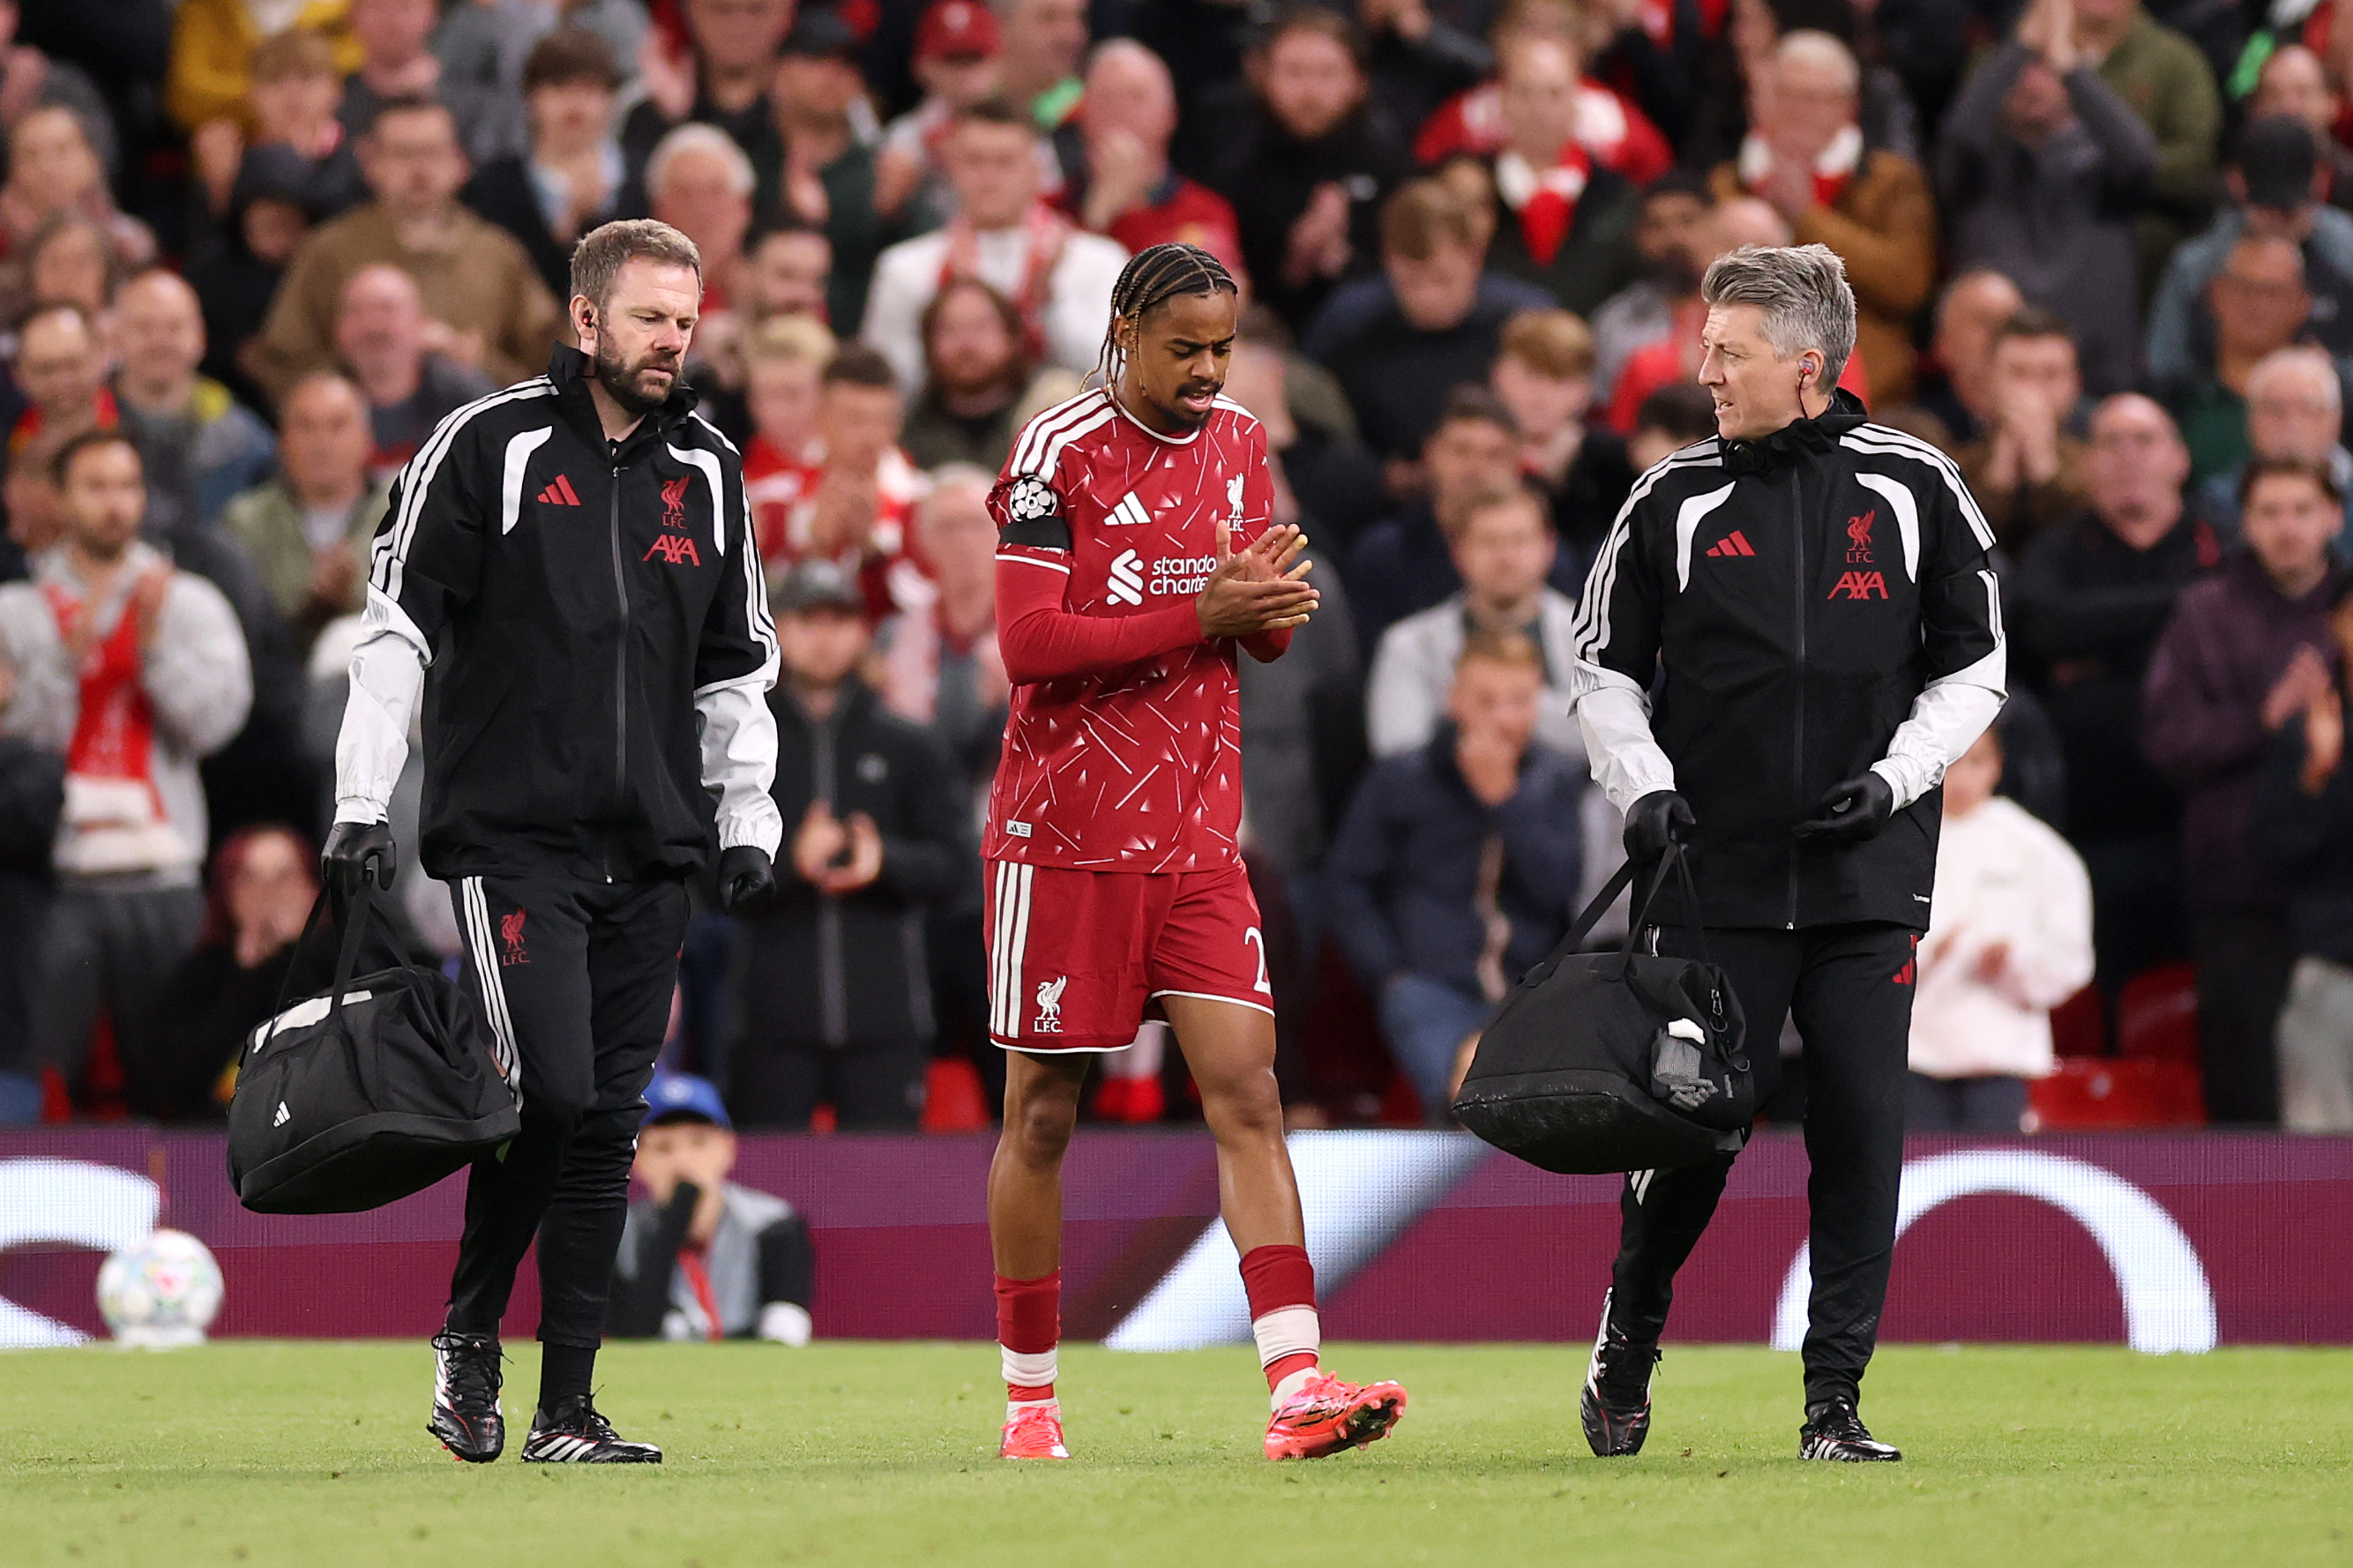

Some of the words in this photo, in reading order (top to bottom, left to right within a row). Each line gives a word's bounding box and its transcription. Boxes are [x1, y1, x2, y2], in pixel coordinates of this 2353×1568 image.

[642, 534, 701, 567] AXA
[1152, 554, 1217, 576] standa
[1149, 574, 1209, 595] charte
[1826, 571, 1890, 600] AXA
